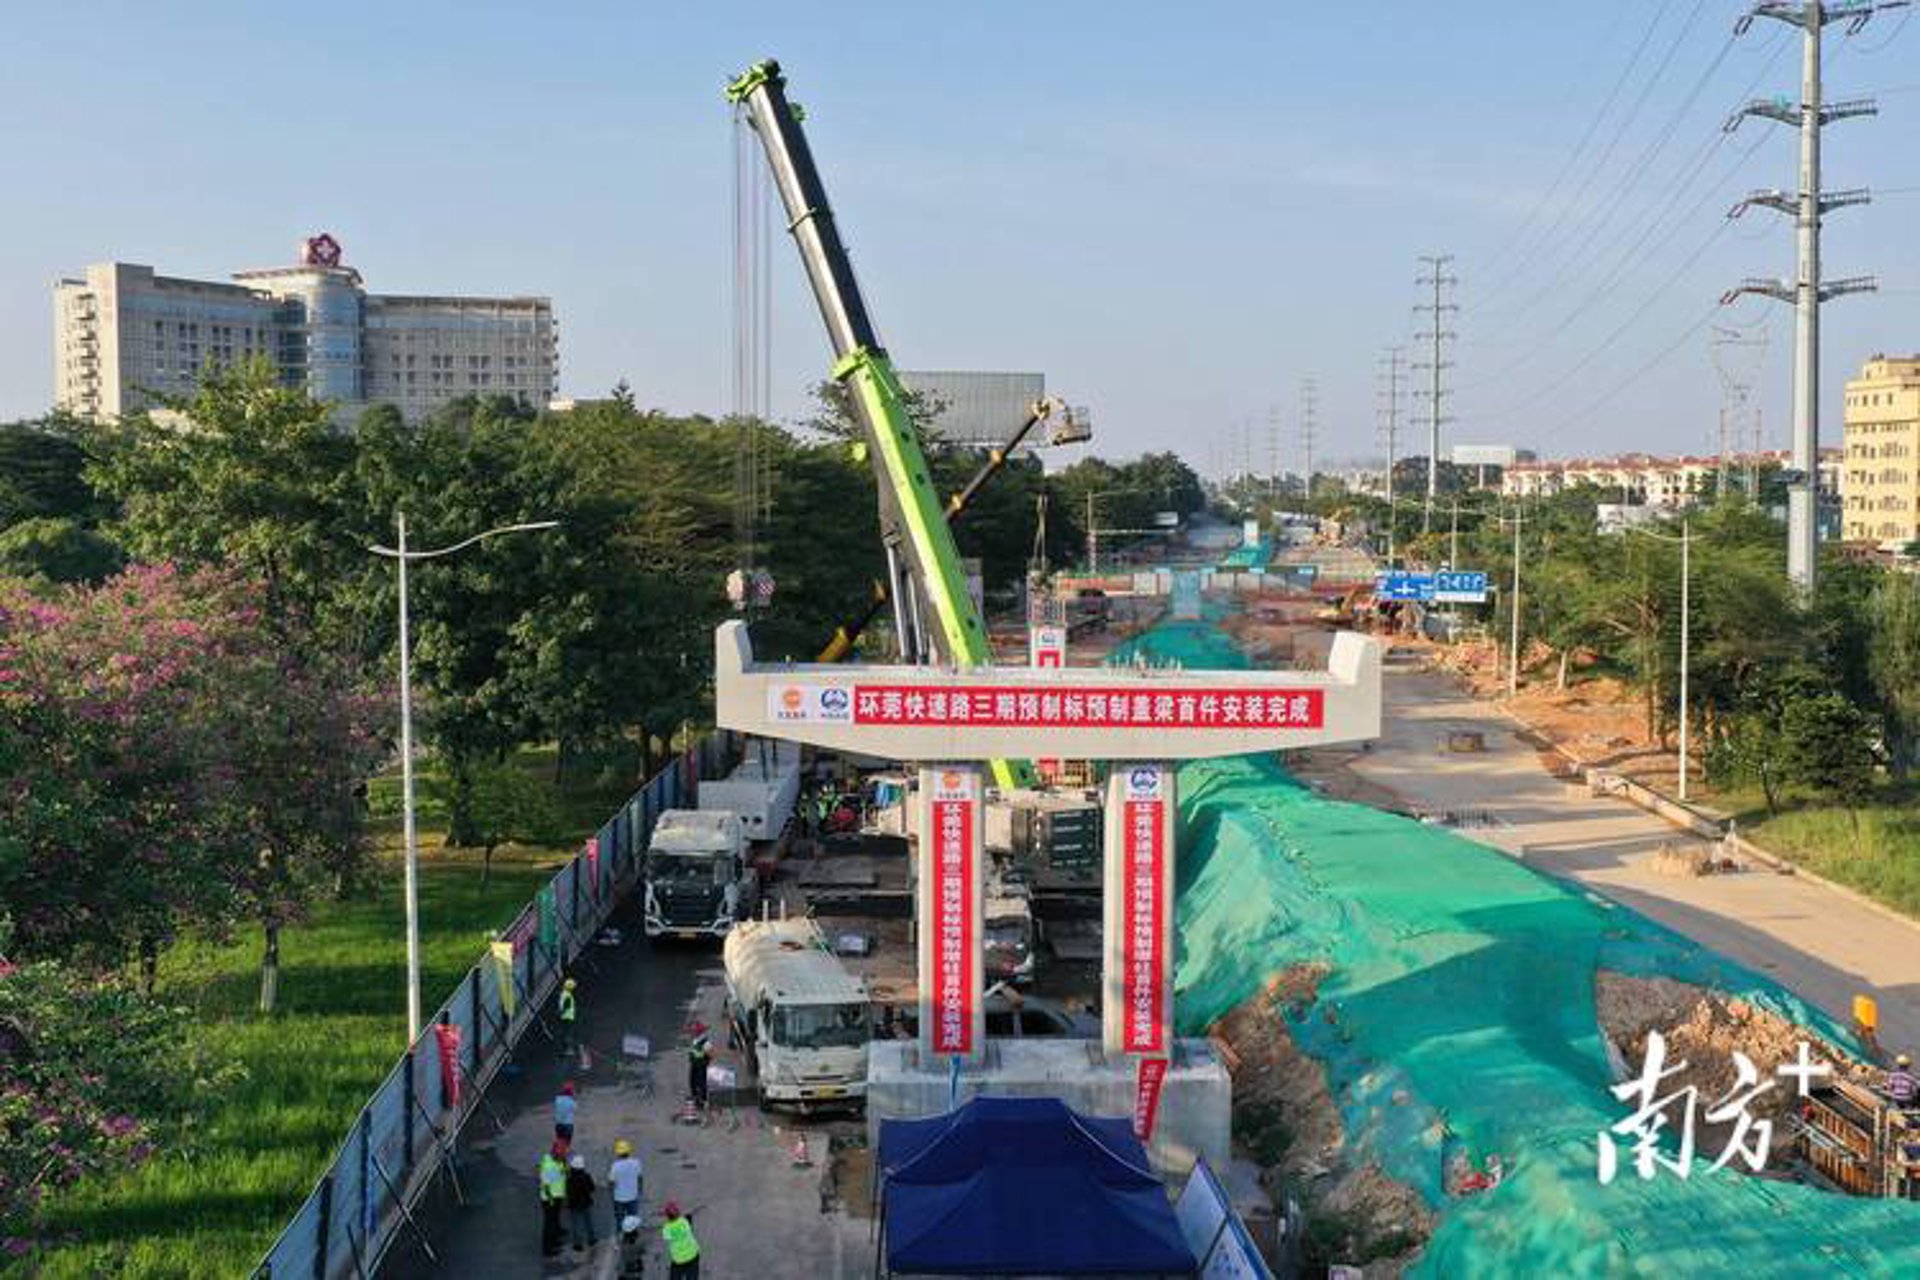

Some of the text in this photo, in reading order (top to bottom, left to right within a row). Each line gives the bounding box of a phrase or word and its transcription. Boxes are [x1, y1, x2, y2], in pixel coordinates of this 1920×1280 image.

[858, 691, 1310, 723] 环莞快速路三期预制标预制盖梁首件安装完成
